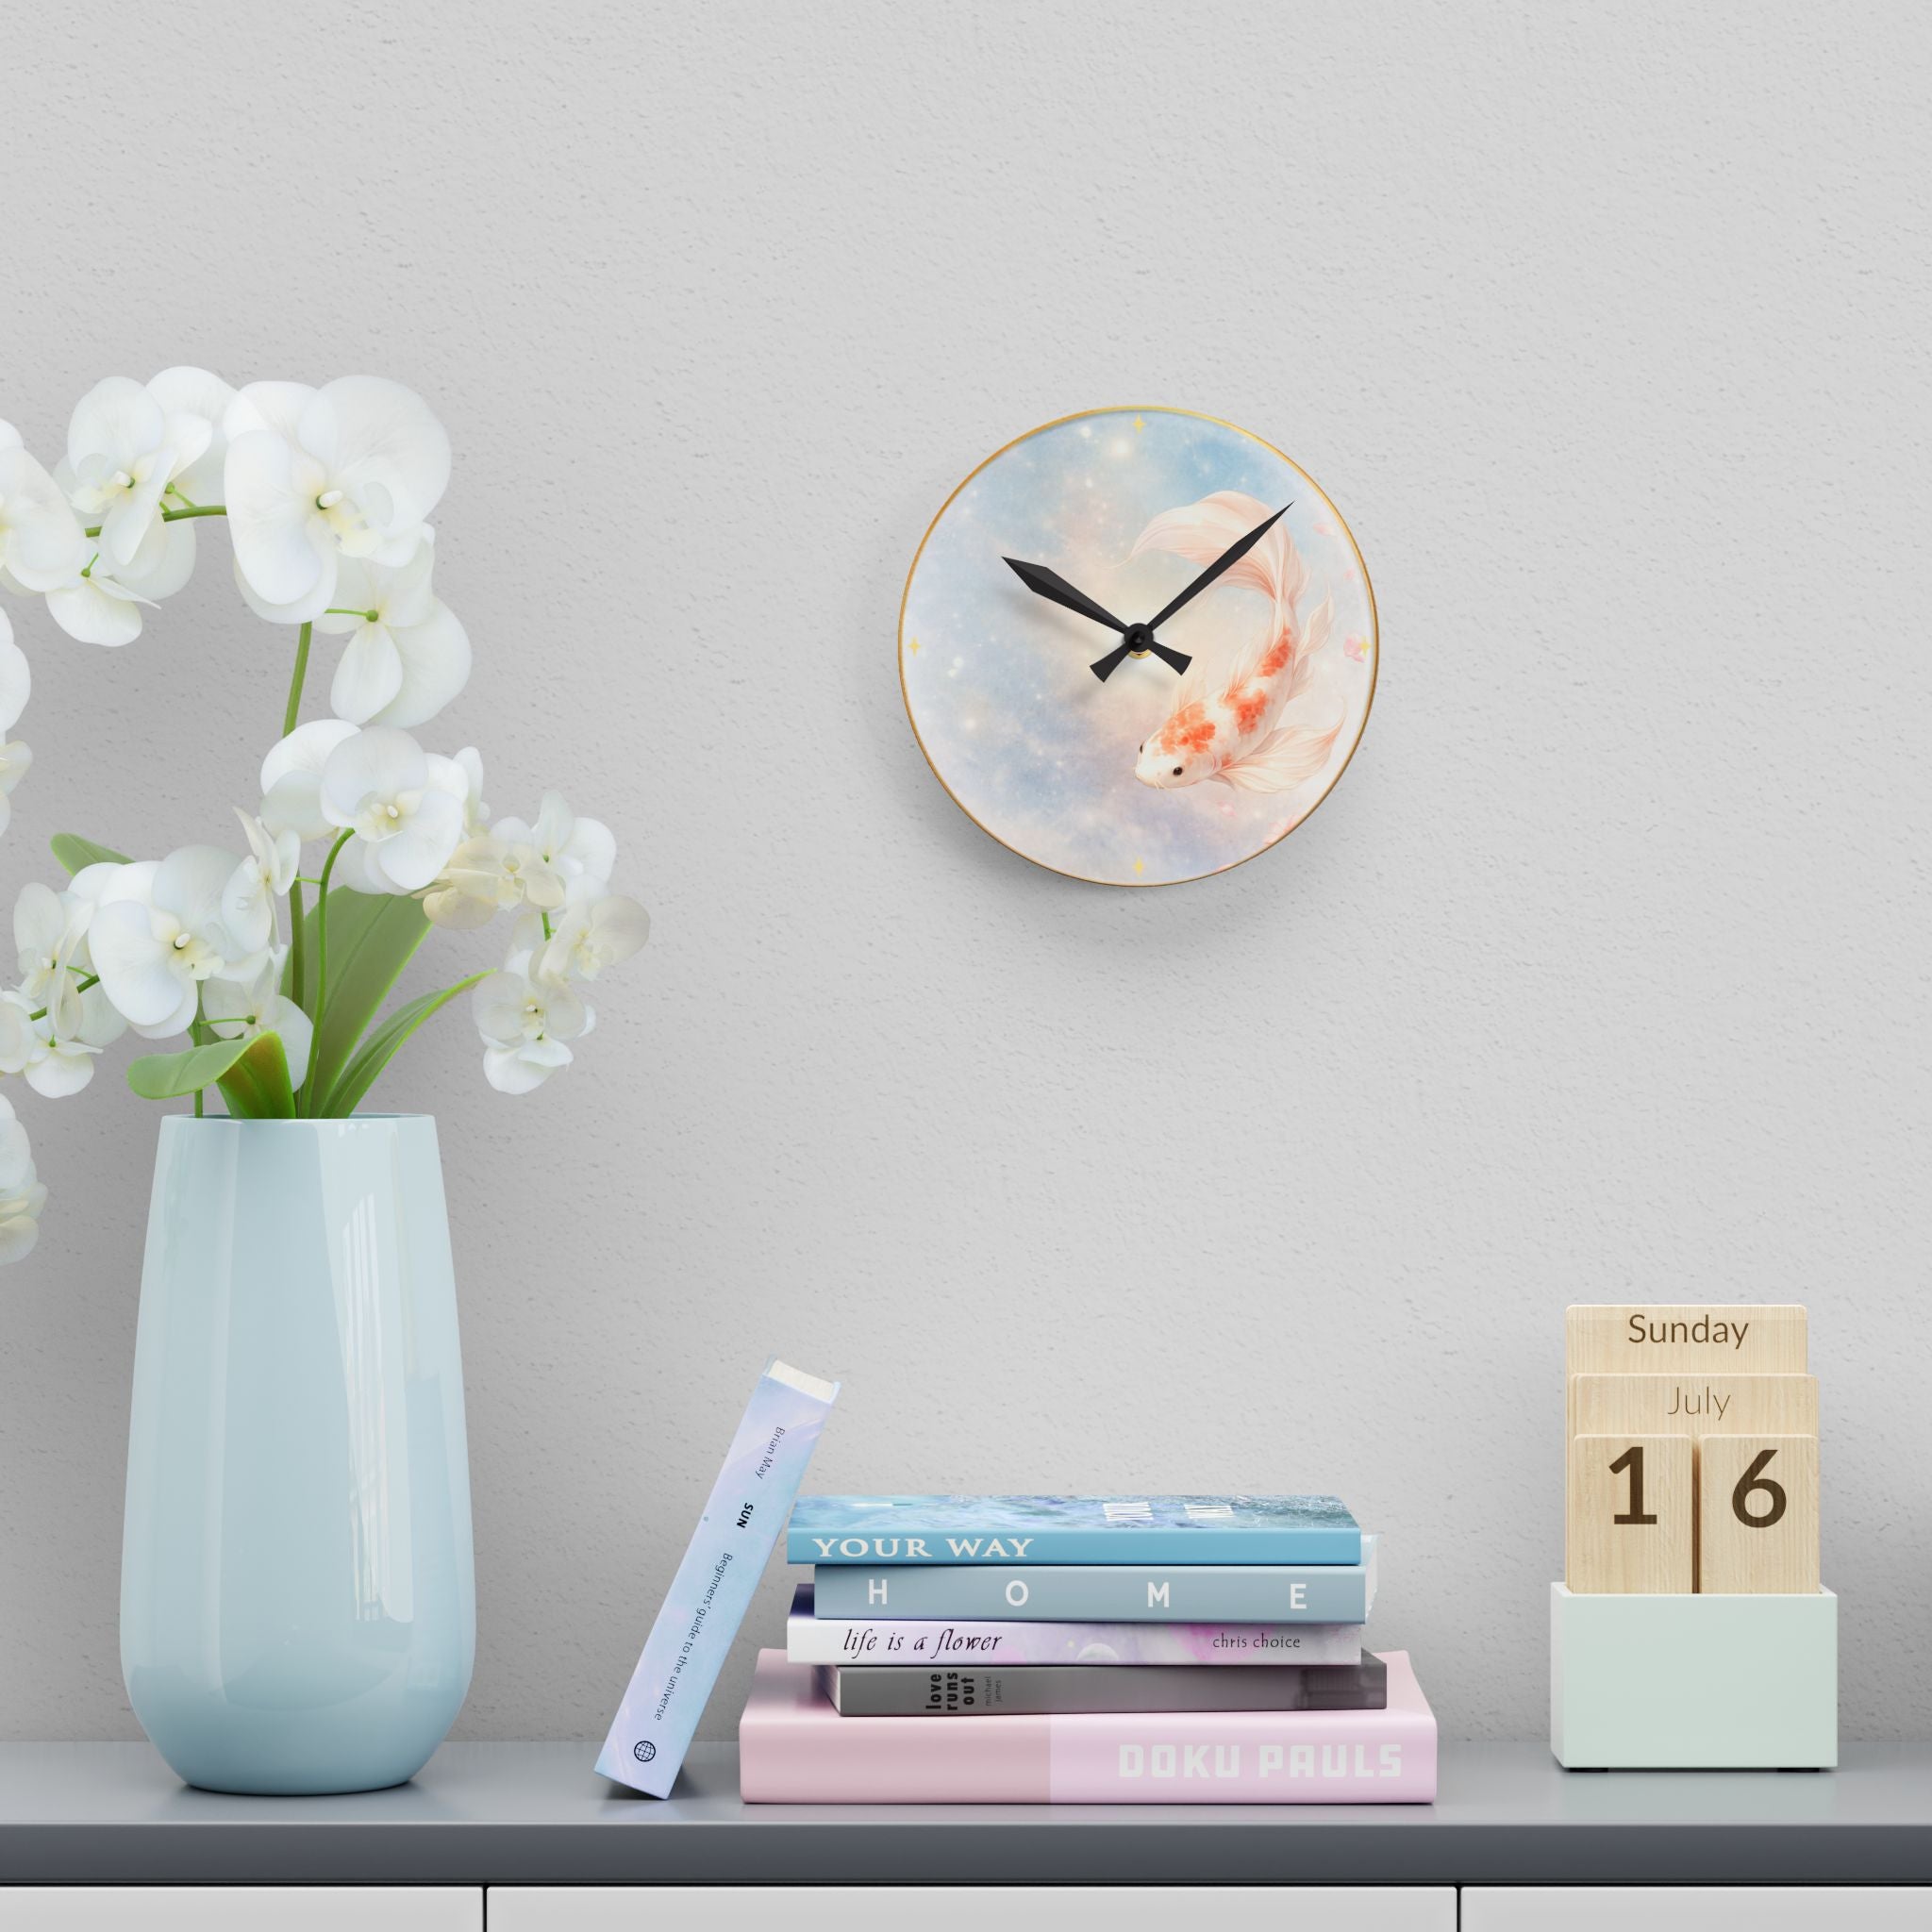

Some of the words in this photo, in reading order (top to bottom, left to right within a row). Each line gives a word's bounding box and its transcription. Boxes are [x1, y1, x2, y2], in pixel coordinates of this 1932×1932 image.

[1628, 1314, 1749, 1350] Sunday
[1667, 1386, 1731, 1421] July
[766, 1426, 786, 1455] Brian
[755, 1456, 774, 1480] May
[736, 1502, 754, 1529] SUN
[812, 1538, 933, 1557] YOUR
[945, 1538, 1035, 1557] WAY
[688, 1607, 707, 1640] guide
[682, 1641, 693, 1654] to
[842, 1628, 877, 1659] life
[887, 1631, 905, 1651] is
[913, 1635, 928, 1651] a
[929, 1628, 1003, 1659] flower
[1212, 1633, 1247, 1649] chris
[1253, 1632, 1301, 1649] choice
[673, 1655, 688, 1674] the
[654, 1675, 678, 1721] universe
[925, 1674, 941, 1709] love
[946, 1673, 958, 1710] runs
[960, 1677, 974, 1706] out
[984, 1676, 993, 1707] michael
[1118, 1744, 1240, 1778] DOKU
[1258, 1744, 1403, 1778] PAULS
